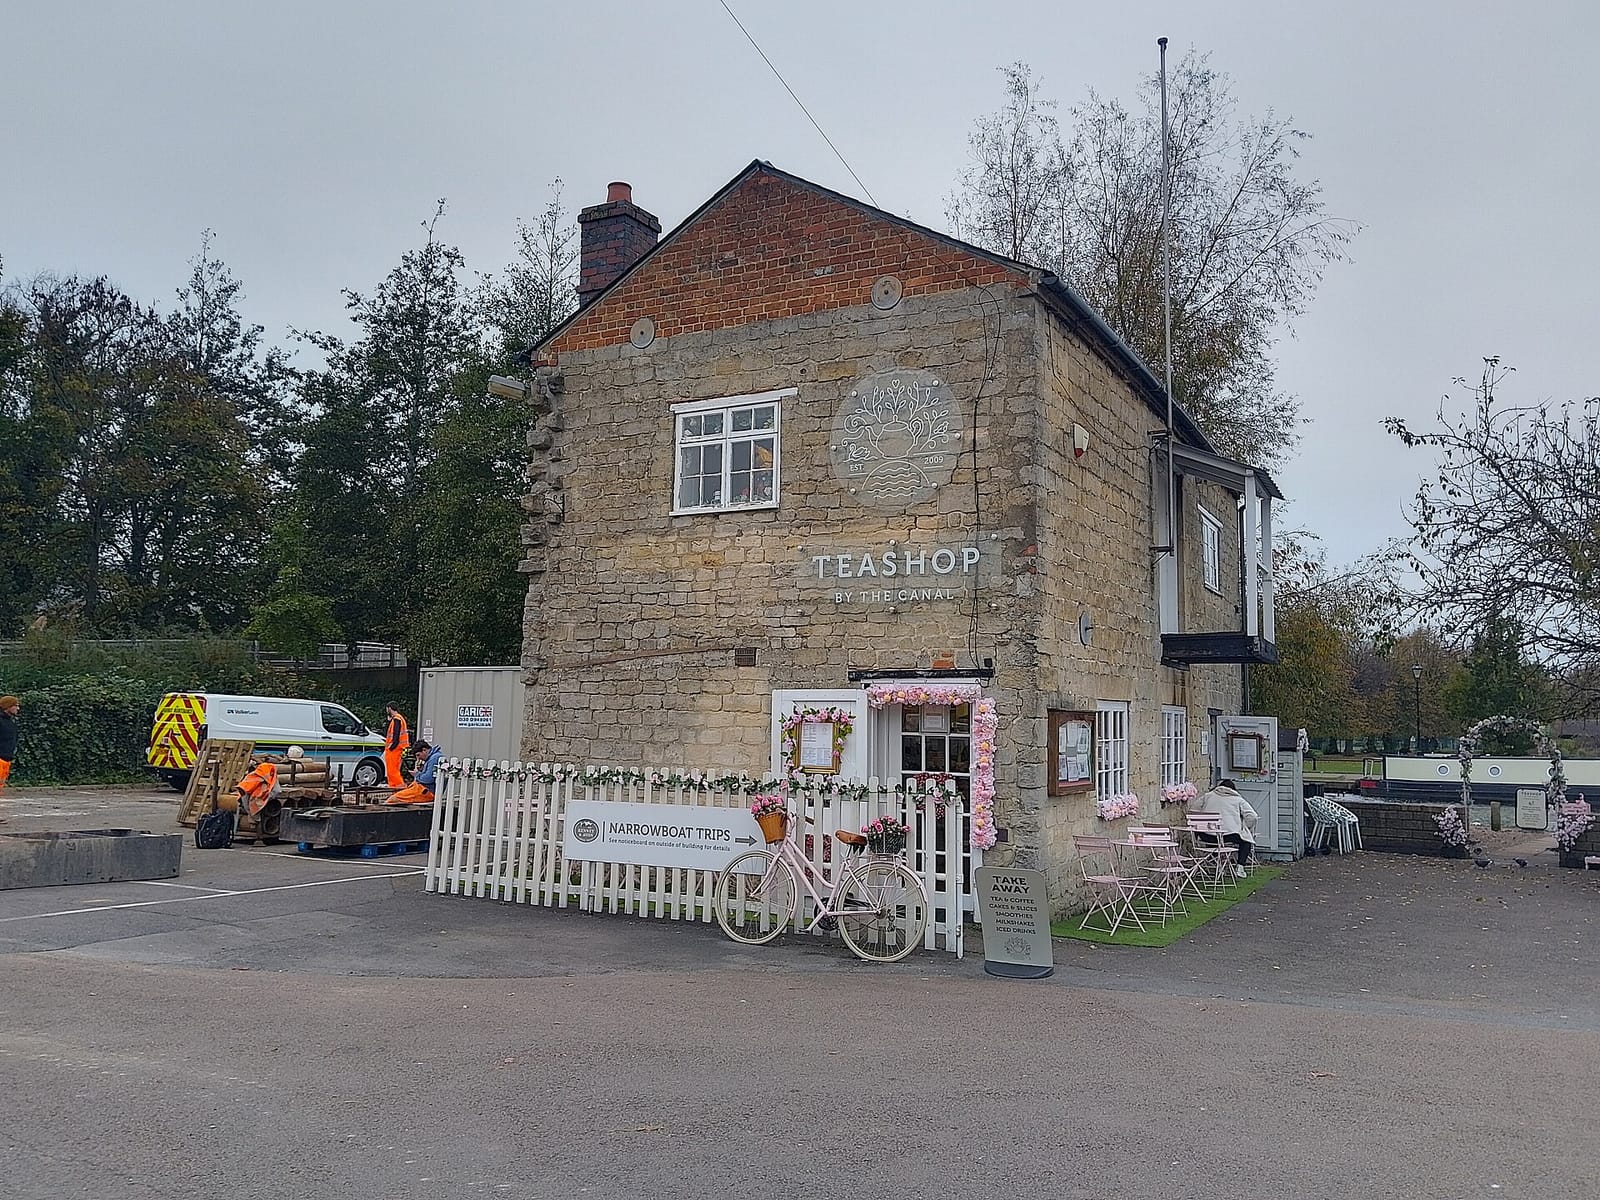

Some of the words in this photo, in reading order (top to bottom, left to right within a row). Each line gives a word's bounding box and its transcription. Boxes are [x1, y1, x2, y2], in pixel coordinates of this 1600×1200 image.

[923, 456, 944, 465] 2009
[849, 463, 865, 472] EST.
[812, 547, 980, 579] TEASHOP
[835, 591, 853, 604] BY
[860, 590, 892, 603] THE
[898, 588, 955, 601] CANAL
[608, 822, 694, 839] NARROWBOAT
[696, 827, 731, 842] TRIPS
[618, 838, 648, 846] noticeboard
[656, 840, 675, 848] outside
[681, 842, 704, 851] building
[712, 844, 731, 852] details
[992, 876, 1026, 885] TAKE
[992, 884, 1030, 894] AWAY
[1009, 897, 1035, 905] COFFEE
[995, 911, 1034, 919] SMOOTHIES
[995, 919, 1035, 927] MILKSHAKES
[1012, 927, 1036, 935] DRINKS
